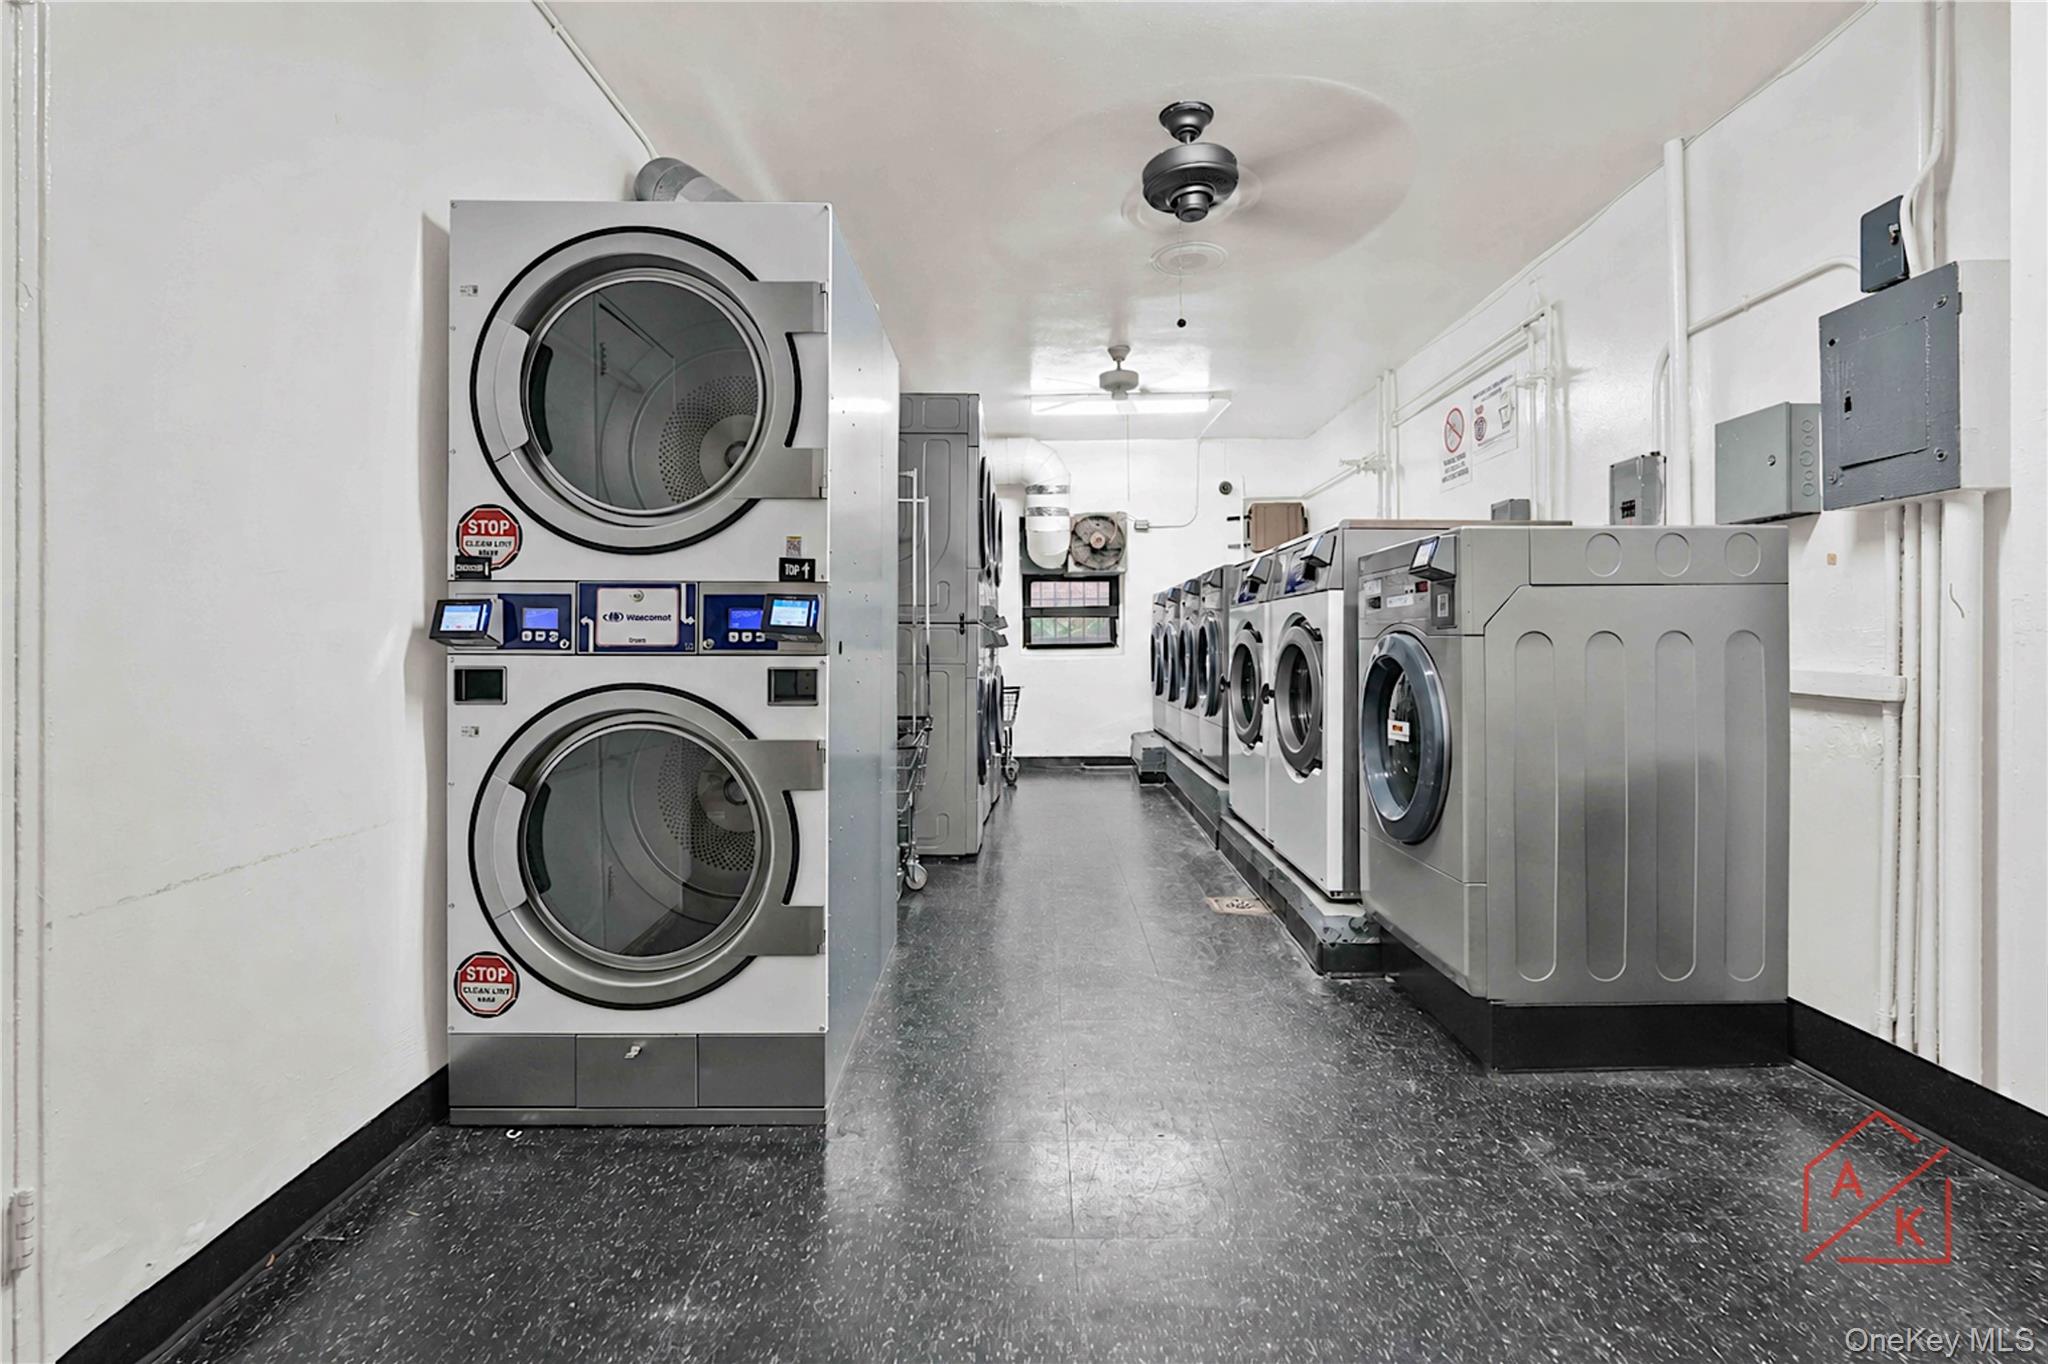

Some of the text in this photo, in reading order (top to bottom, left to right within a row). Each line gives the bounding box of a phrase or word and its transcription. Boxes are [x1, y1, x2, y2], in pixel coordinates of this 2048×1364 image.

[468, 520, 510, 535] STOP
[785, 563, 800, 576] TOP
[466, 966, 508, 982] STOP
